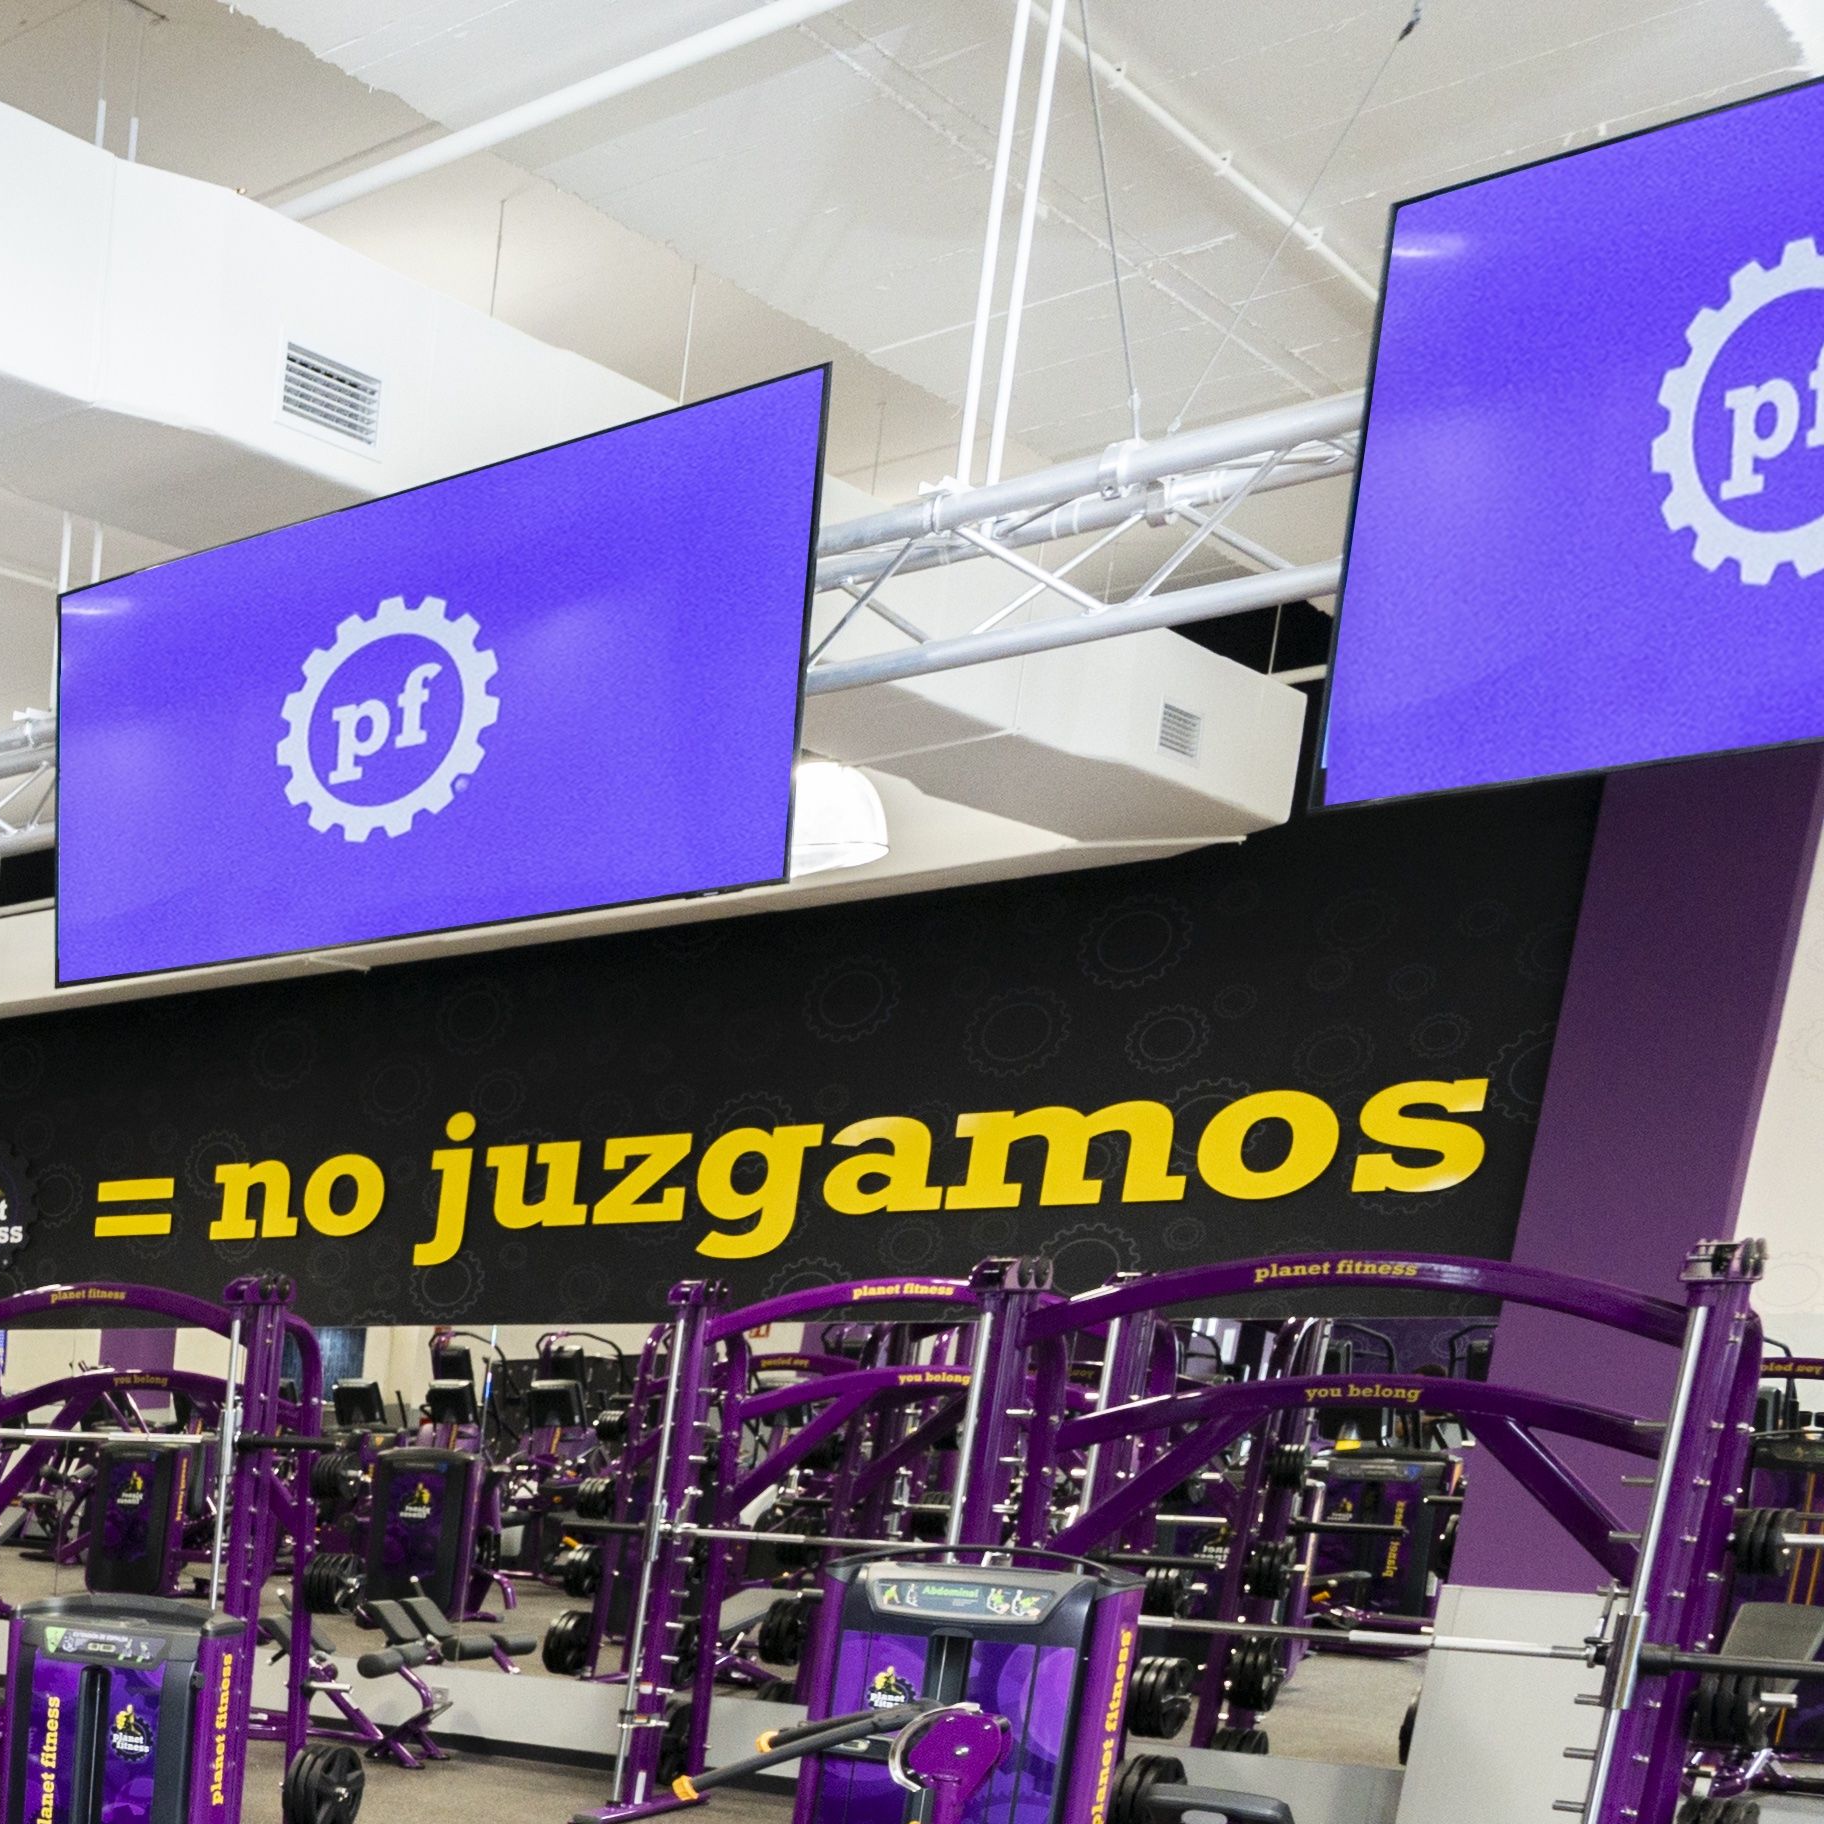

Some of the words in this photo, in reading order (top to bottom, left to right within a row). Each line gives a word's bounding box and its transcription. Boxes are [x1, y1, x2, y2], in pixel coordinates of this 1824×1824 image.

[329, 663, 442, 784] pf
[94, 1177, 175, 1238] =
[209, 1153, 386, 1241] no
[412, 1077, 1489, 1266] juzgamos
[1255, 1264, 1329, 1282] planet
[1337, 1260, 1417, 1275] fitness
[50, 1291, 85, 1303] planet
[87, 1289, 126, 1300] fitness
[853, 1286, 899, 1299] planet
[903, 1283, 954, 1296] fitness
[134, 1374, 168, 1387] belong
[899, 1373, 923, 1386] you
[925, 1372, 971, 1386] belong
[1304, 1386, 1344, 1400] you
[1347, 1384, 1423, 1402] belong
[922, 1585, 980, 1598] Abdominal
[1104, 1629, 1133, 1732] fitness
[215, 1653, 233, 1740] fitness
[870, 1691, 906, 1704] planet
[41, 1697, 60, 1768] fitness
[112, 1732, 144, 1747] planet
[116, 1741, 150, 1754] fitness
[210, 1741, 225, 1806] planet
